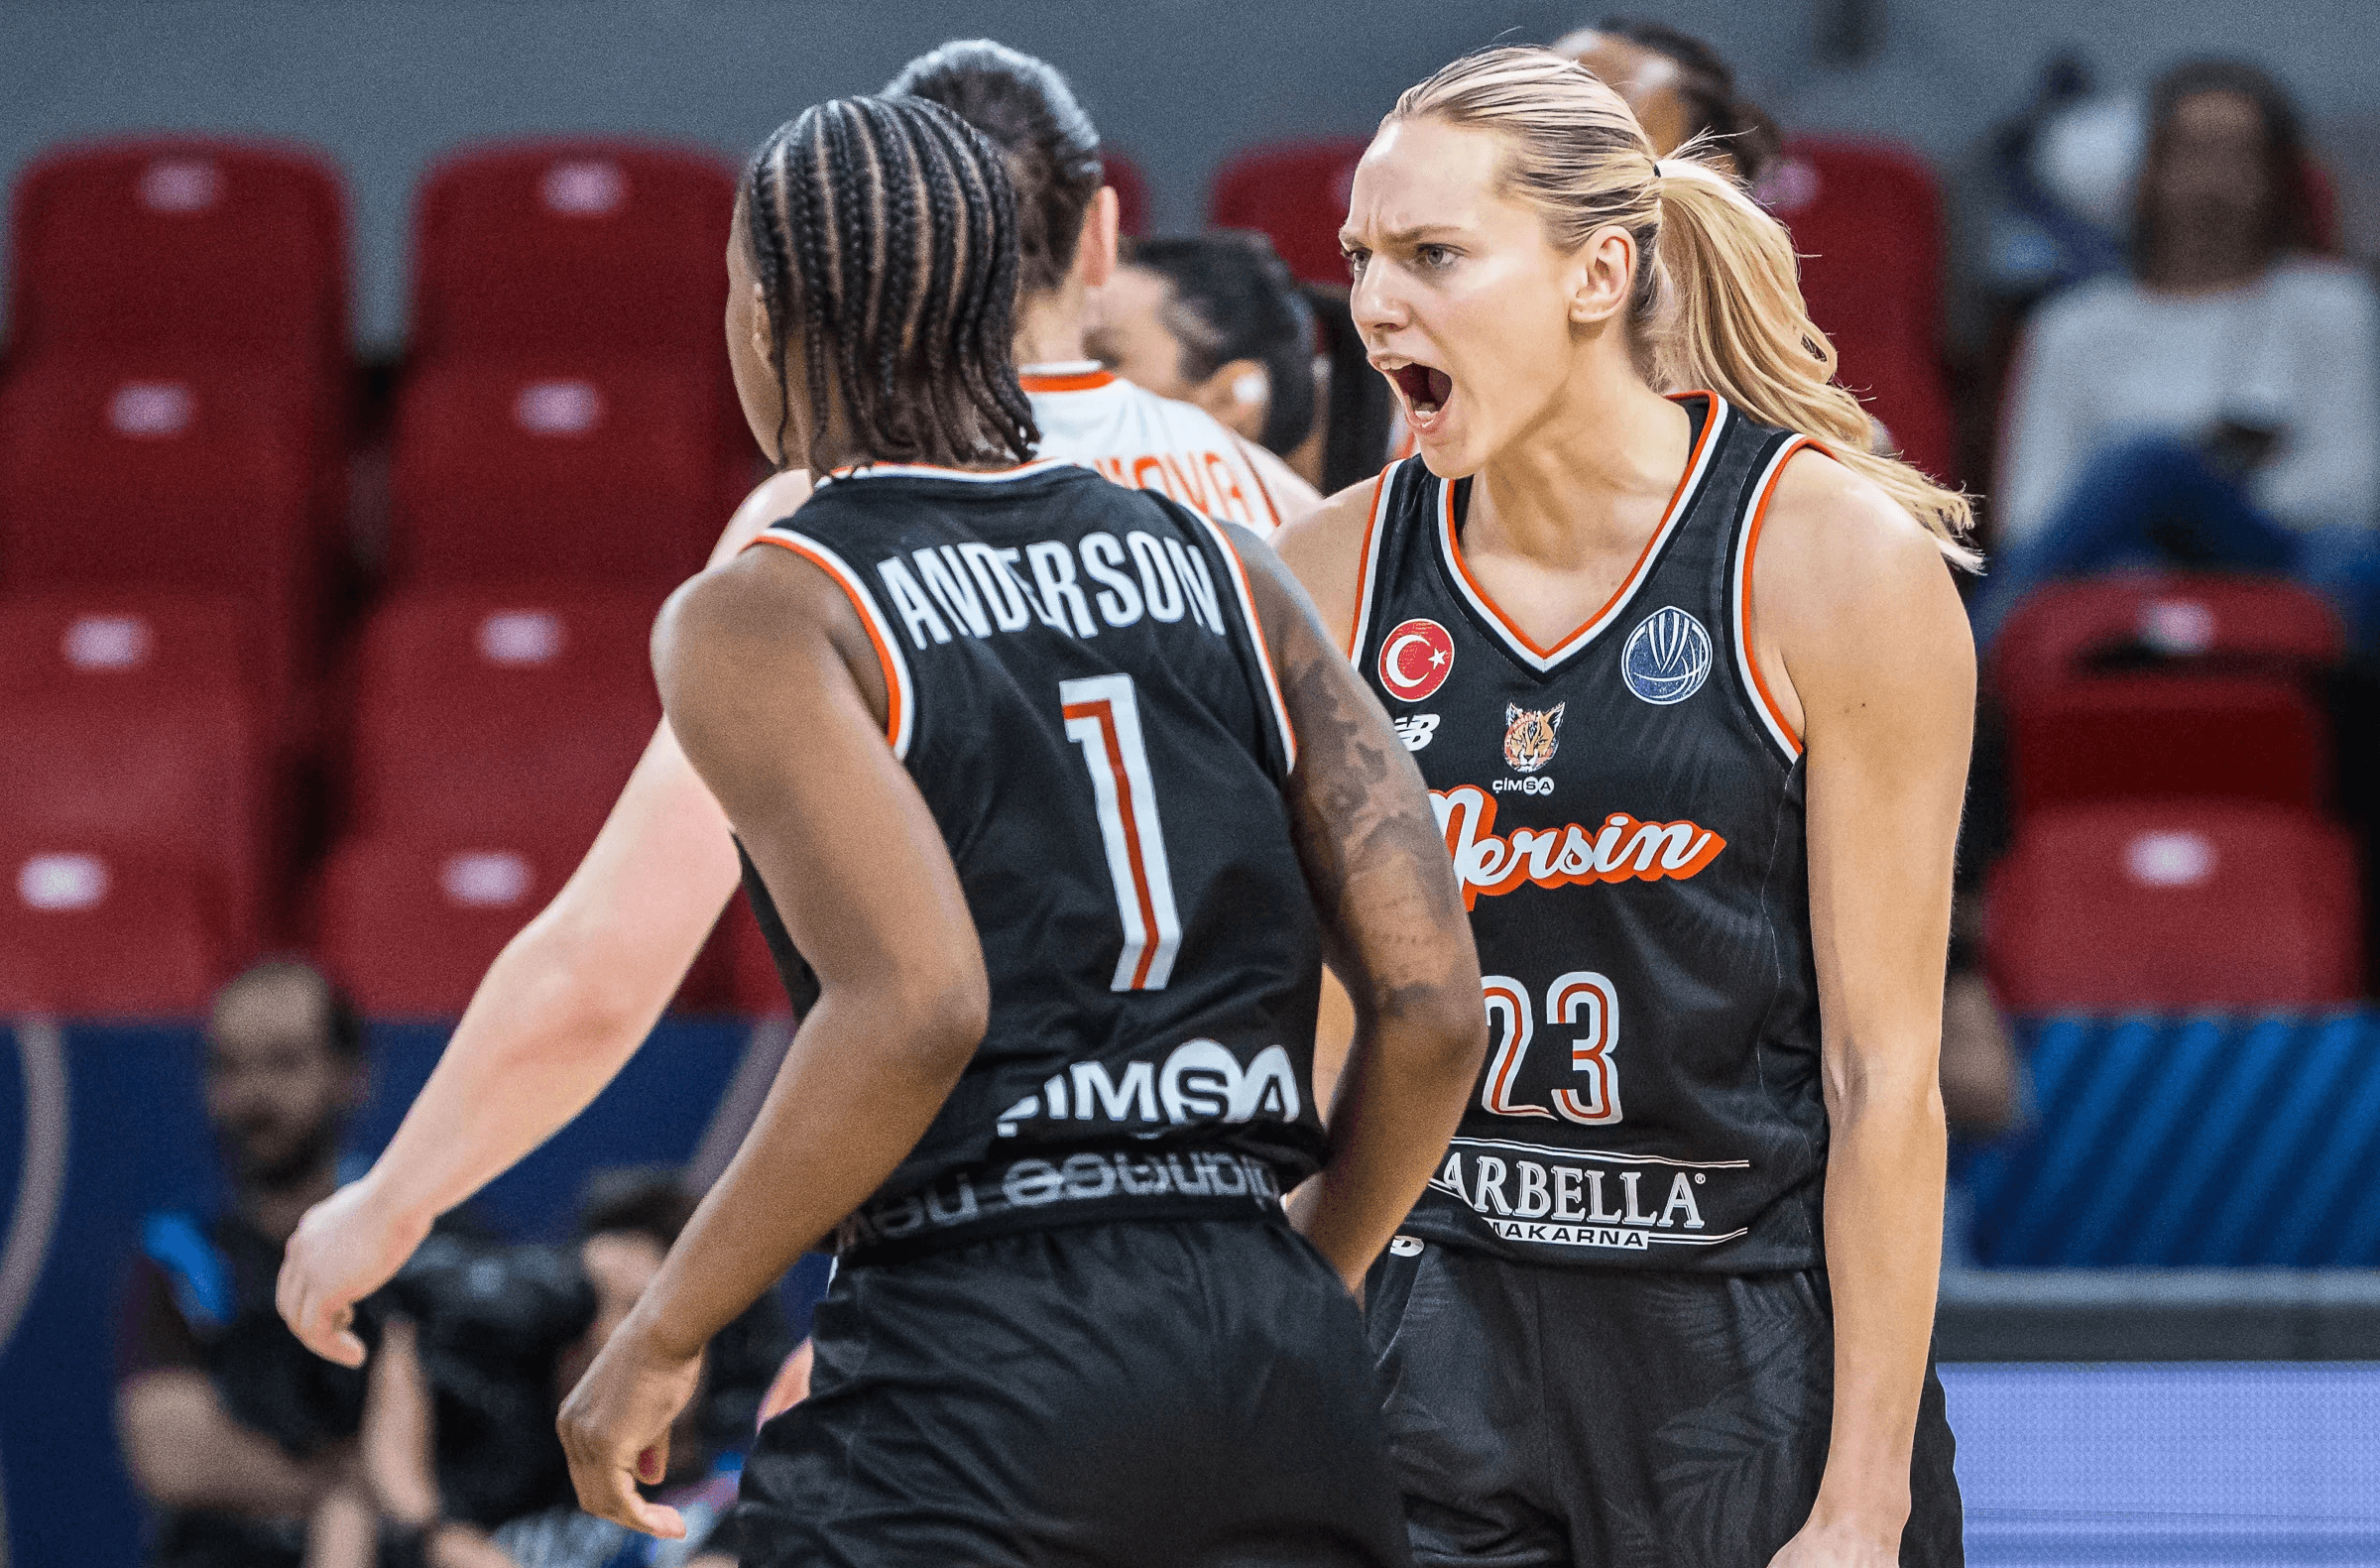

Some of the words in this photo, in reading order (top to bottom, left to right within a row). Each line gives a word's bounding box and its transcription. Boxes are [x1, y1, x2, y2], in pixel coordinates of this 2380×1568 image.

[877, 531, 1226, 650] ANDERSON
[1059, 672, 1183, 993] 1
[1482, 971, 1623, 1125] 23
